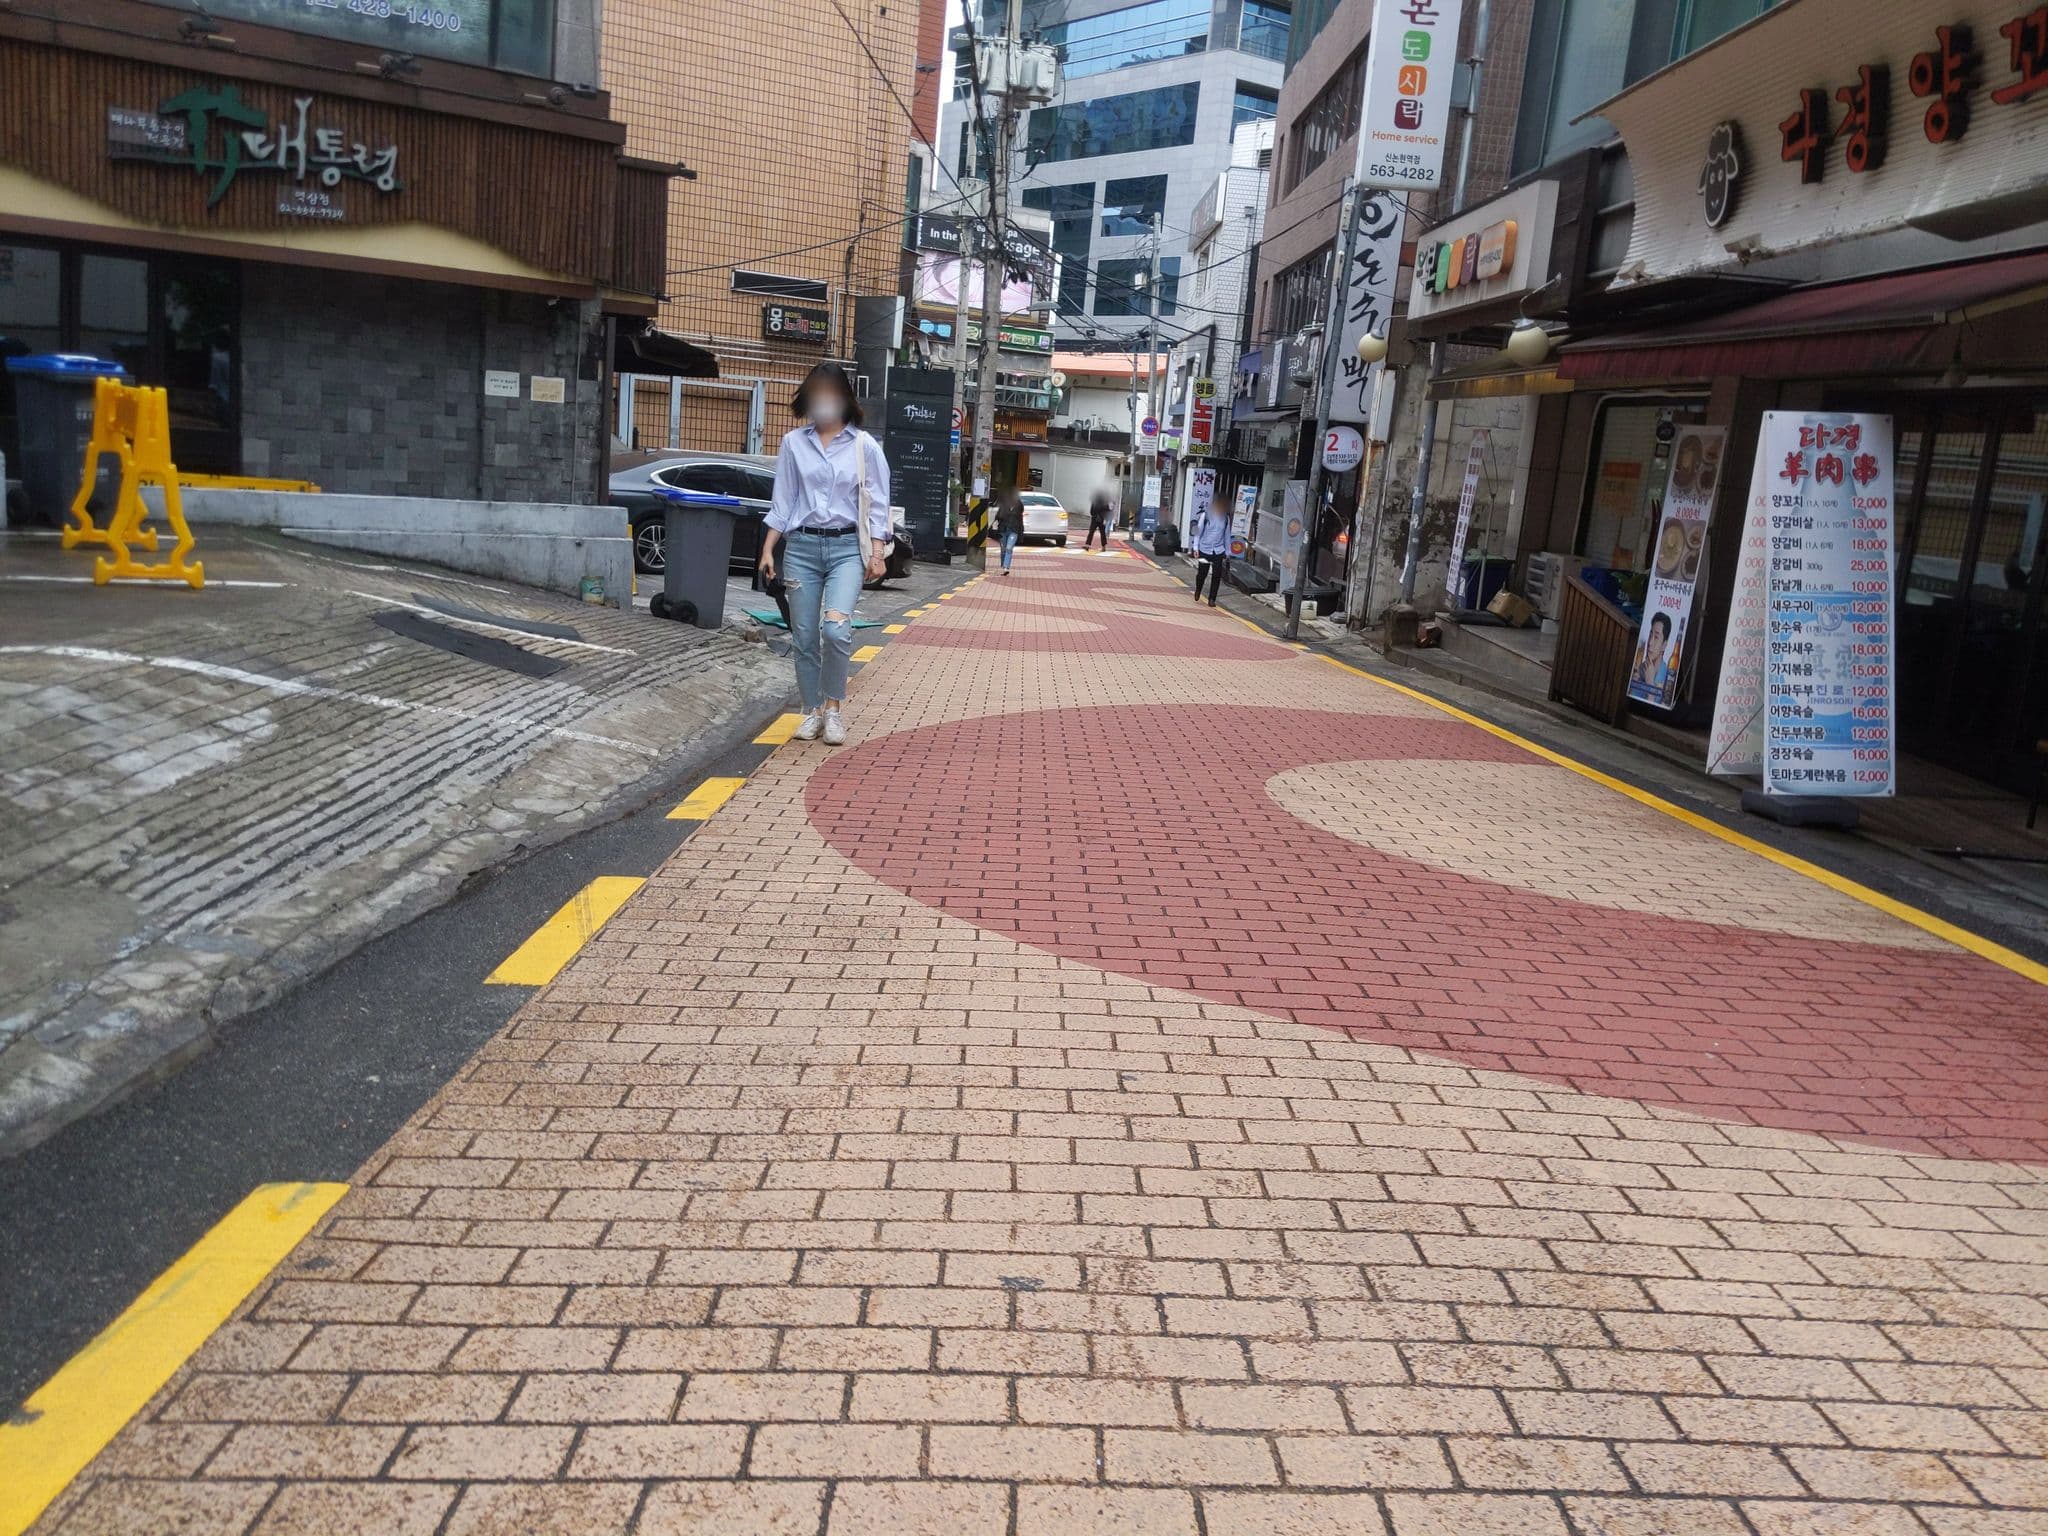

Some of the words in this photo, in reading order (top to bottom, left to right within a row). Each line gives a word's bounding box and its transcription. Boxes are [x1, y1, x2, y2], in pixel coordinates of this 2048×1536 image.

[241, 97, 399, 191] 대통령
[1372, 130, 1402, 143] Home
[1404, 134, 1439, 145] service
[1369, 164, 1434, 181] 563-4282
[930, 227, 940, 238] In
[941, 230, 958, 241] the
[1191, 396, 1213, 444] 노래
[1327, 433, 1339, 452] 2
[1799, 423, 1860, 450] 다경
[911, 443, 924, 453] 29
[1779, 451, 1879, 485] 羊肉串
[1772, 494, 1803, 508] 양꼬치
[1852, 497, 1887, 510] 12,000
[1772, 516, 1814, 529] 양갈비살
[1852, 517, 1887, 530] 13,000
[1772, 536, 1802, 550] 양갈비
[1852, 539, 1887, 551] 18,000
[1772, 557, 1802, 571] 왕갈비
[1851, 560, 1887, 572] 25,000
[1771, 578, 1802, 592] 닭날개
[1851, 581, 1887, 593] 10,000
[1771, 600, 1813, 613] 새우구이
[1851, 602, 1887, 615] 12,000
[1771, 621, 1802, 634] 탕수육
[1851, 623, 1887, 635] 16,000
[1852, 644, 1887, 656] 18,000
[1770, 663, 1814, 676] 가지볶음
[1852, 664, 1888, 677] 15,000
[1770, 684, 1814, 698] 마파두부
[1852, 686, 1888, 698] 12,000
[1852, 707, 1888, 720] 16,000
[1770, 726, 1824, 740] 건두부볶음
[1852, 728, 1888, 740] 12,000
[1852, 749, 1888, 761] 16,000
[1853, 770, 1888, 782] 12,000
